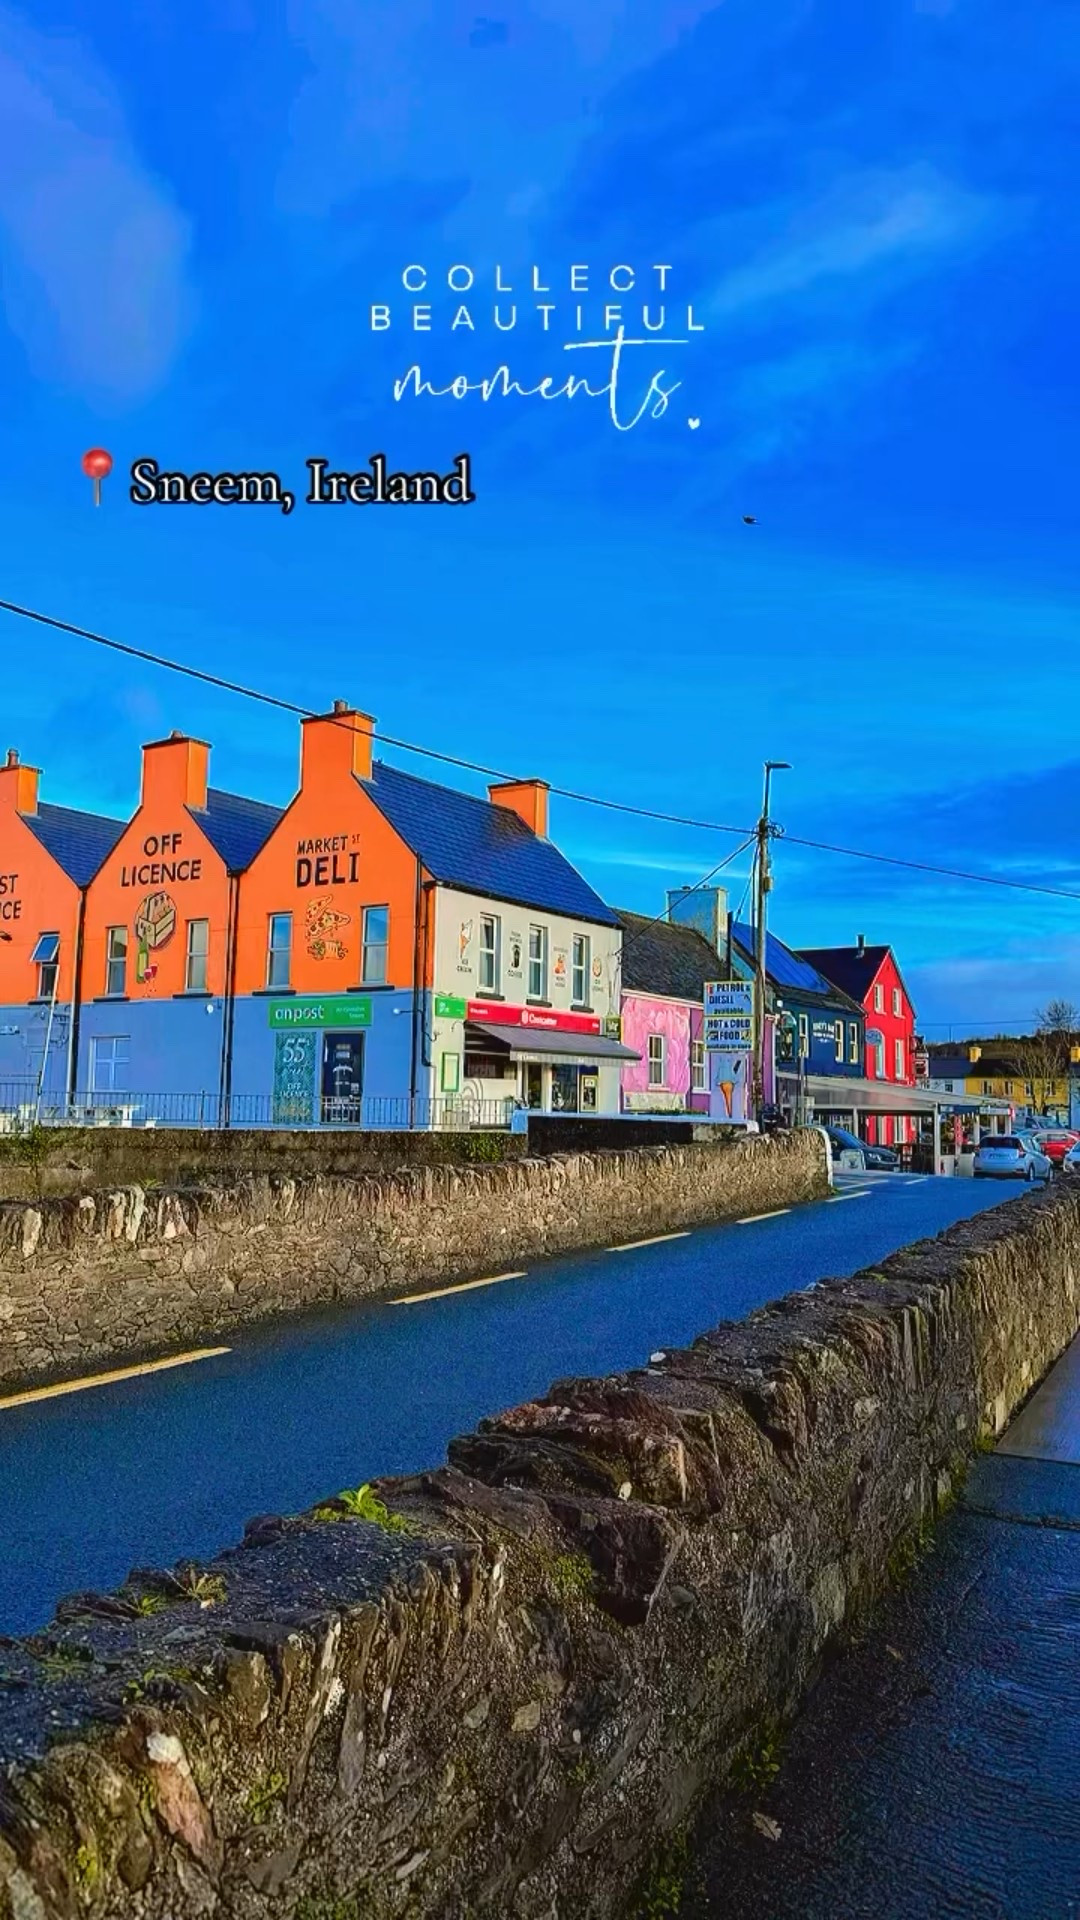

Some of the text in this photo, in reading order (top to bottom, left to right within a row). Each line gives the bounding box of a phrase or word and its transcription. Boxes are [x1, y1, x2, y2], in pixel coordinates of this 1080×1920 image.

[143, 833, 182, 857] OFF
[297, 835, 348, 856] MARKET
[121, 859, 202, 888] LICENCE
[296, 851, 361, 889] DELI
[0, 900, 21, 920] CE
[709, 995, 734, 1005] DIESEL
[707, 1019, 723, 1029] HOT
[730, 1018, 751, 1029] COLD
[719, 1031, 740, 1041] FOOD
